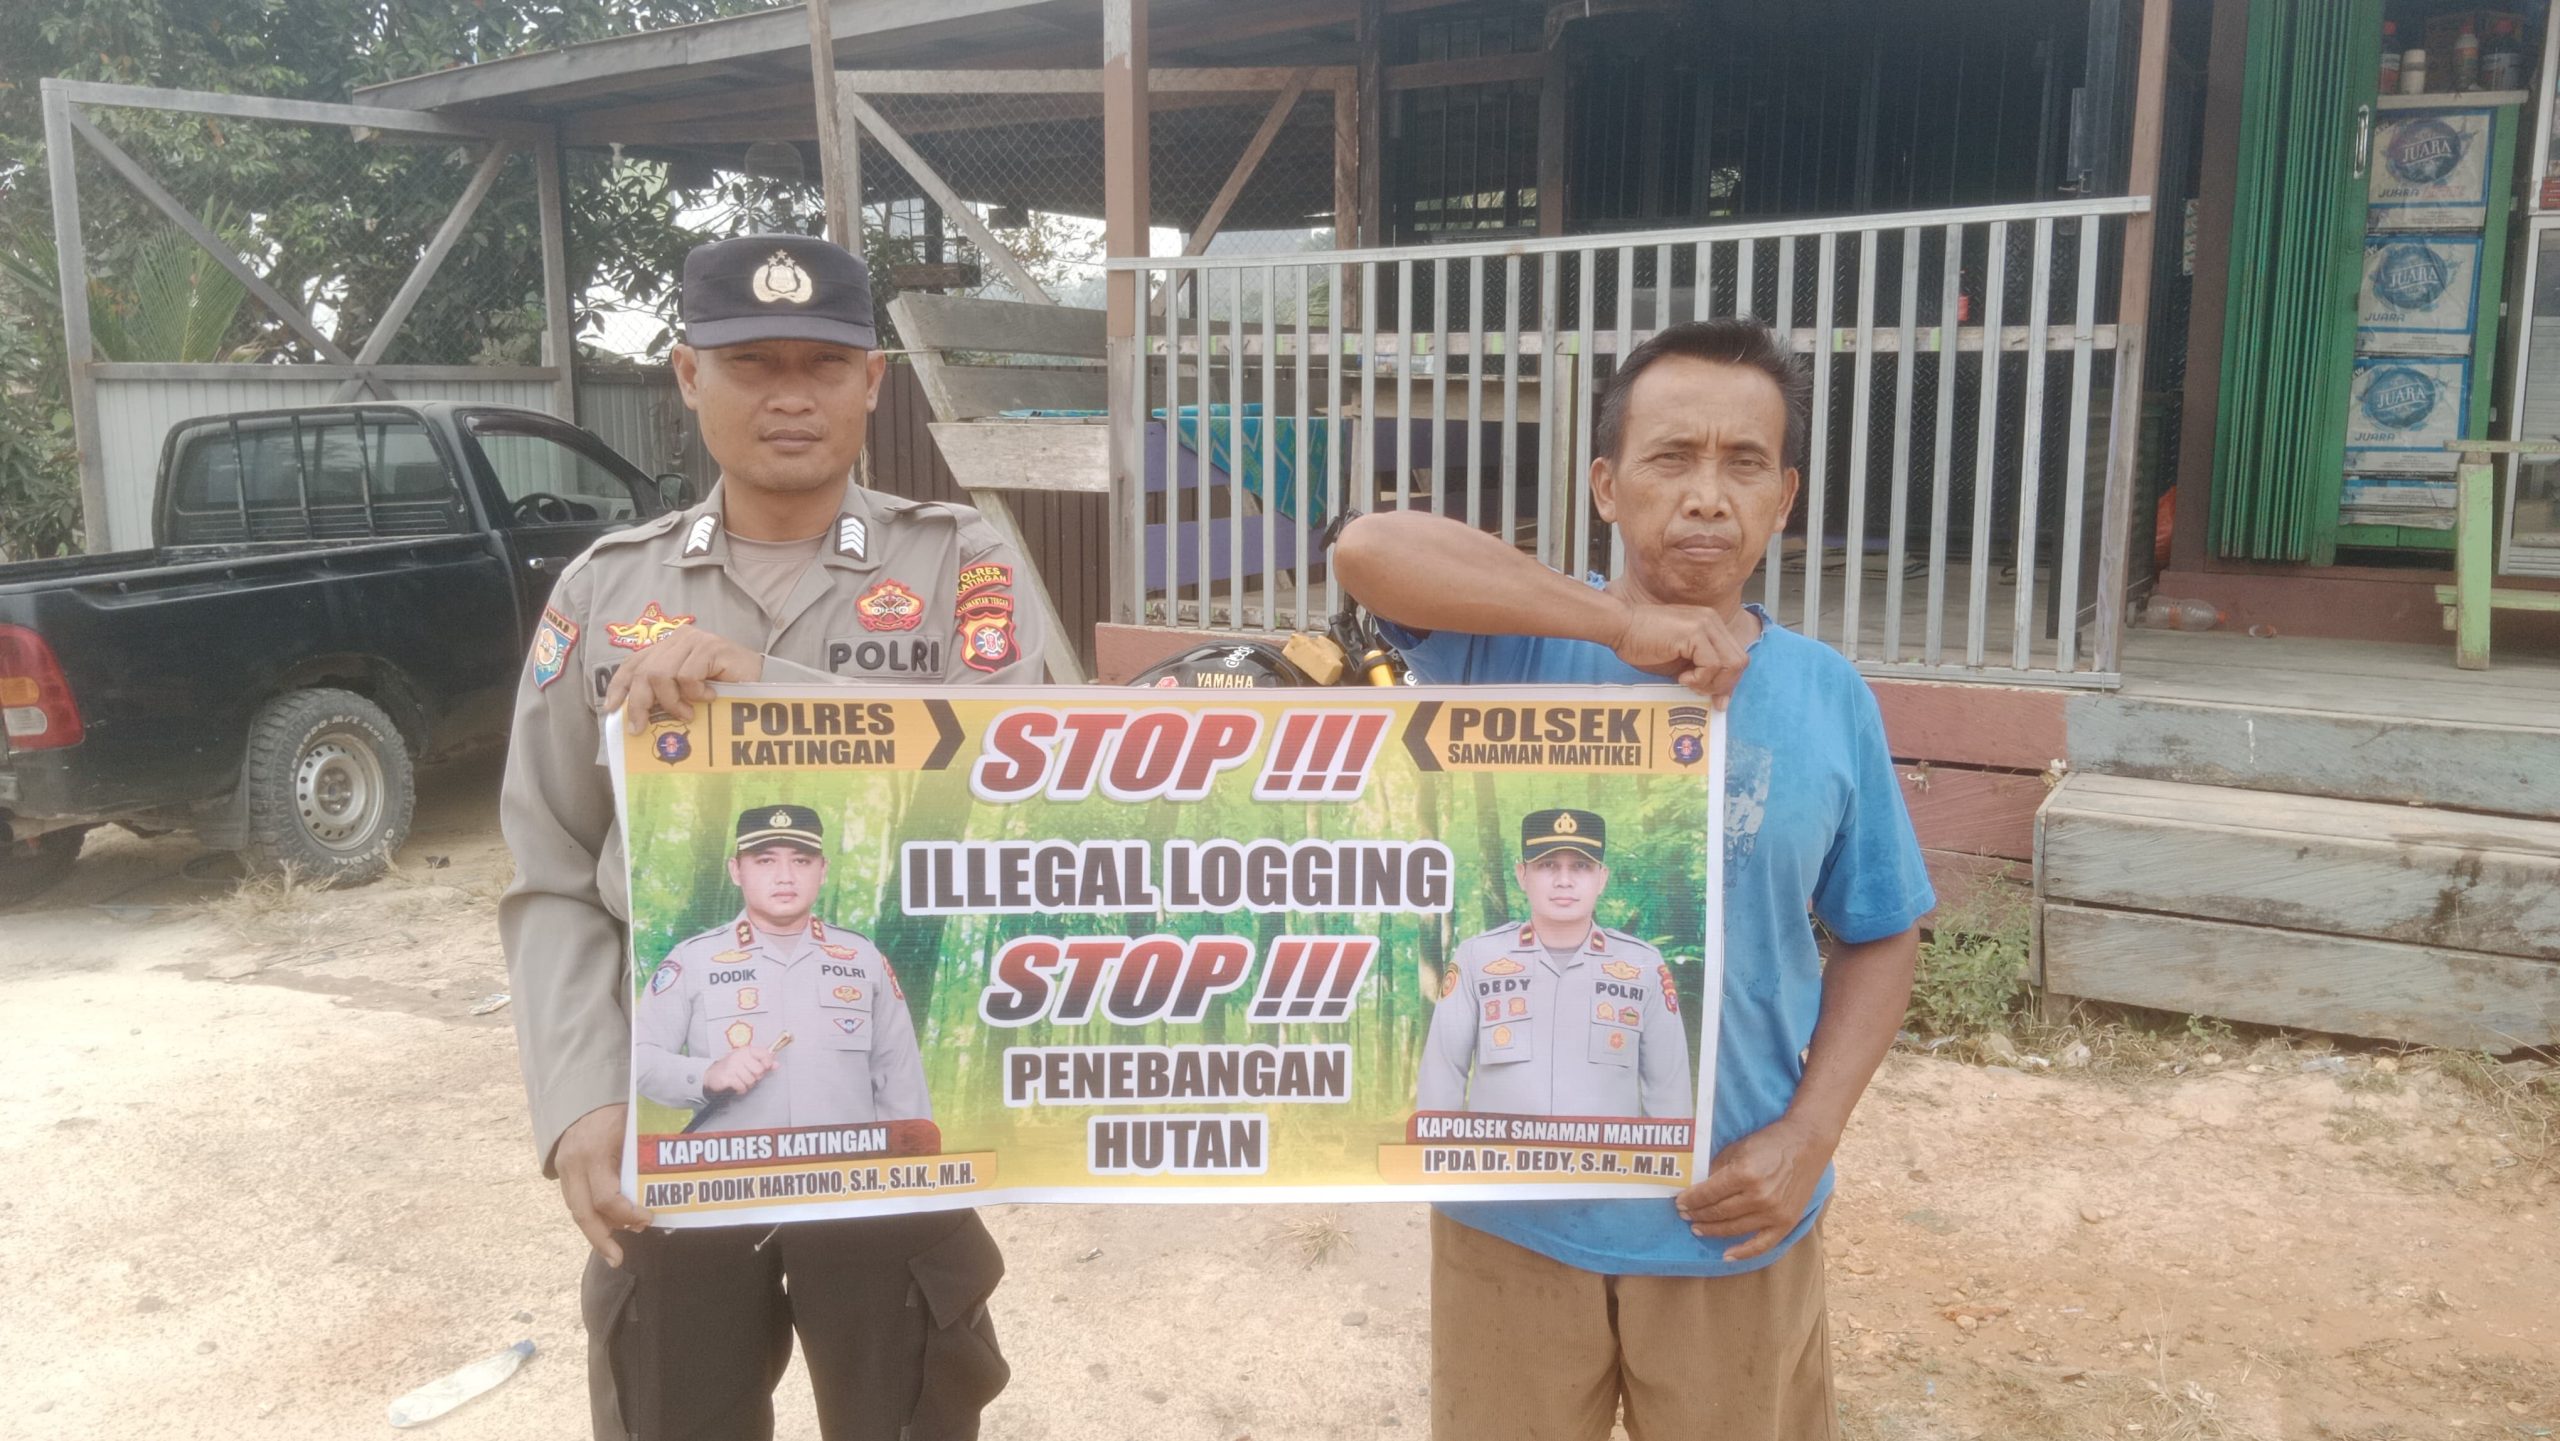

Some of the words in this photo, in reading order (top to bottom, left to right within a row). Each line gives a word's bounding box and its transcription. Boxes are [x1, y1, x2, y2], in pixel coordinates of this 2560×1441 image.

[2402, 139, 2452, 163] JUARA
[2389, 265, 2439, 288] JUARA
[2364, 313, 2406, 323] JUARA
[2376, 386, 2427, 409] JUARA
[2354, 432, 2396, 442] JUARA
[958, 566, 1001, 583] OLRES
[829, 640, 940, 674] POLRI
[1197, 672, 1255, 688] YAMAHA
[731, 702, 896, 737] POLRES
[1449, 707, 1641, 744] POLSEK
[731, 738, 896, 766] KATINGAN
[979, 711, 1258, 793] STOP
[1262, 713, 1390, 792] !!!
[1448, 743, 1543, 765] SANAMAN
[1549, 745, 1642, 767] MANTIKEI
[908, 846, 1154, 909] ILLEGAL
[1170, 845, 1448, 908] LOGGING
[708, 968, 757, 986] DODIK
[821, 964, 867, 979] POLRI
[986, 940, 1249, 1020] STOP
[1253, 942, 1374, 1018] !!!
[1478, 978, 1532, 997] DEDY
[1594, 980, 1644, 1002] POLRI
[1010, 1049, 1347, 1101] PENEBANGAN
[1093, 1119, 1263, 1169] HUTAN
[1416, 1116, 1507, 1140] KAPOLSEK
[1511, 1120, 1599, 1144] SANAMAN
[1603, 1123, 1690, 1146] MANTIKEI
[658, 1134, 772, 1166] KAPOLRES
[777, 1127, 888, 1158] KATINGAN
[1424, 1149, 1477, 1172] IPDA
[1482, 1150, 1511, 1173] Dr.
[1516, 1150, 1576, 1175] DEDY,
[1580, 1152, 1629, 1175] S.H.,
[1633, 1154, 1682, 1178] M.H.
[645, 1182, 694, 1207] AKBP
[700, 1176, 756, 1203] DODIK
[759, 1170, 846, 1198] HARTONO,
[850, 1168, 887, 1193] S.H.,
[889, 1165, 936, 1189] S.I.K.,
[939, 1162, 976, 1186] M.H.
